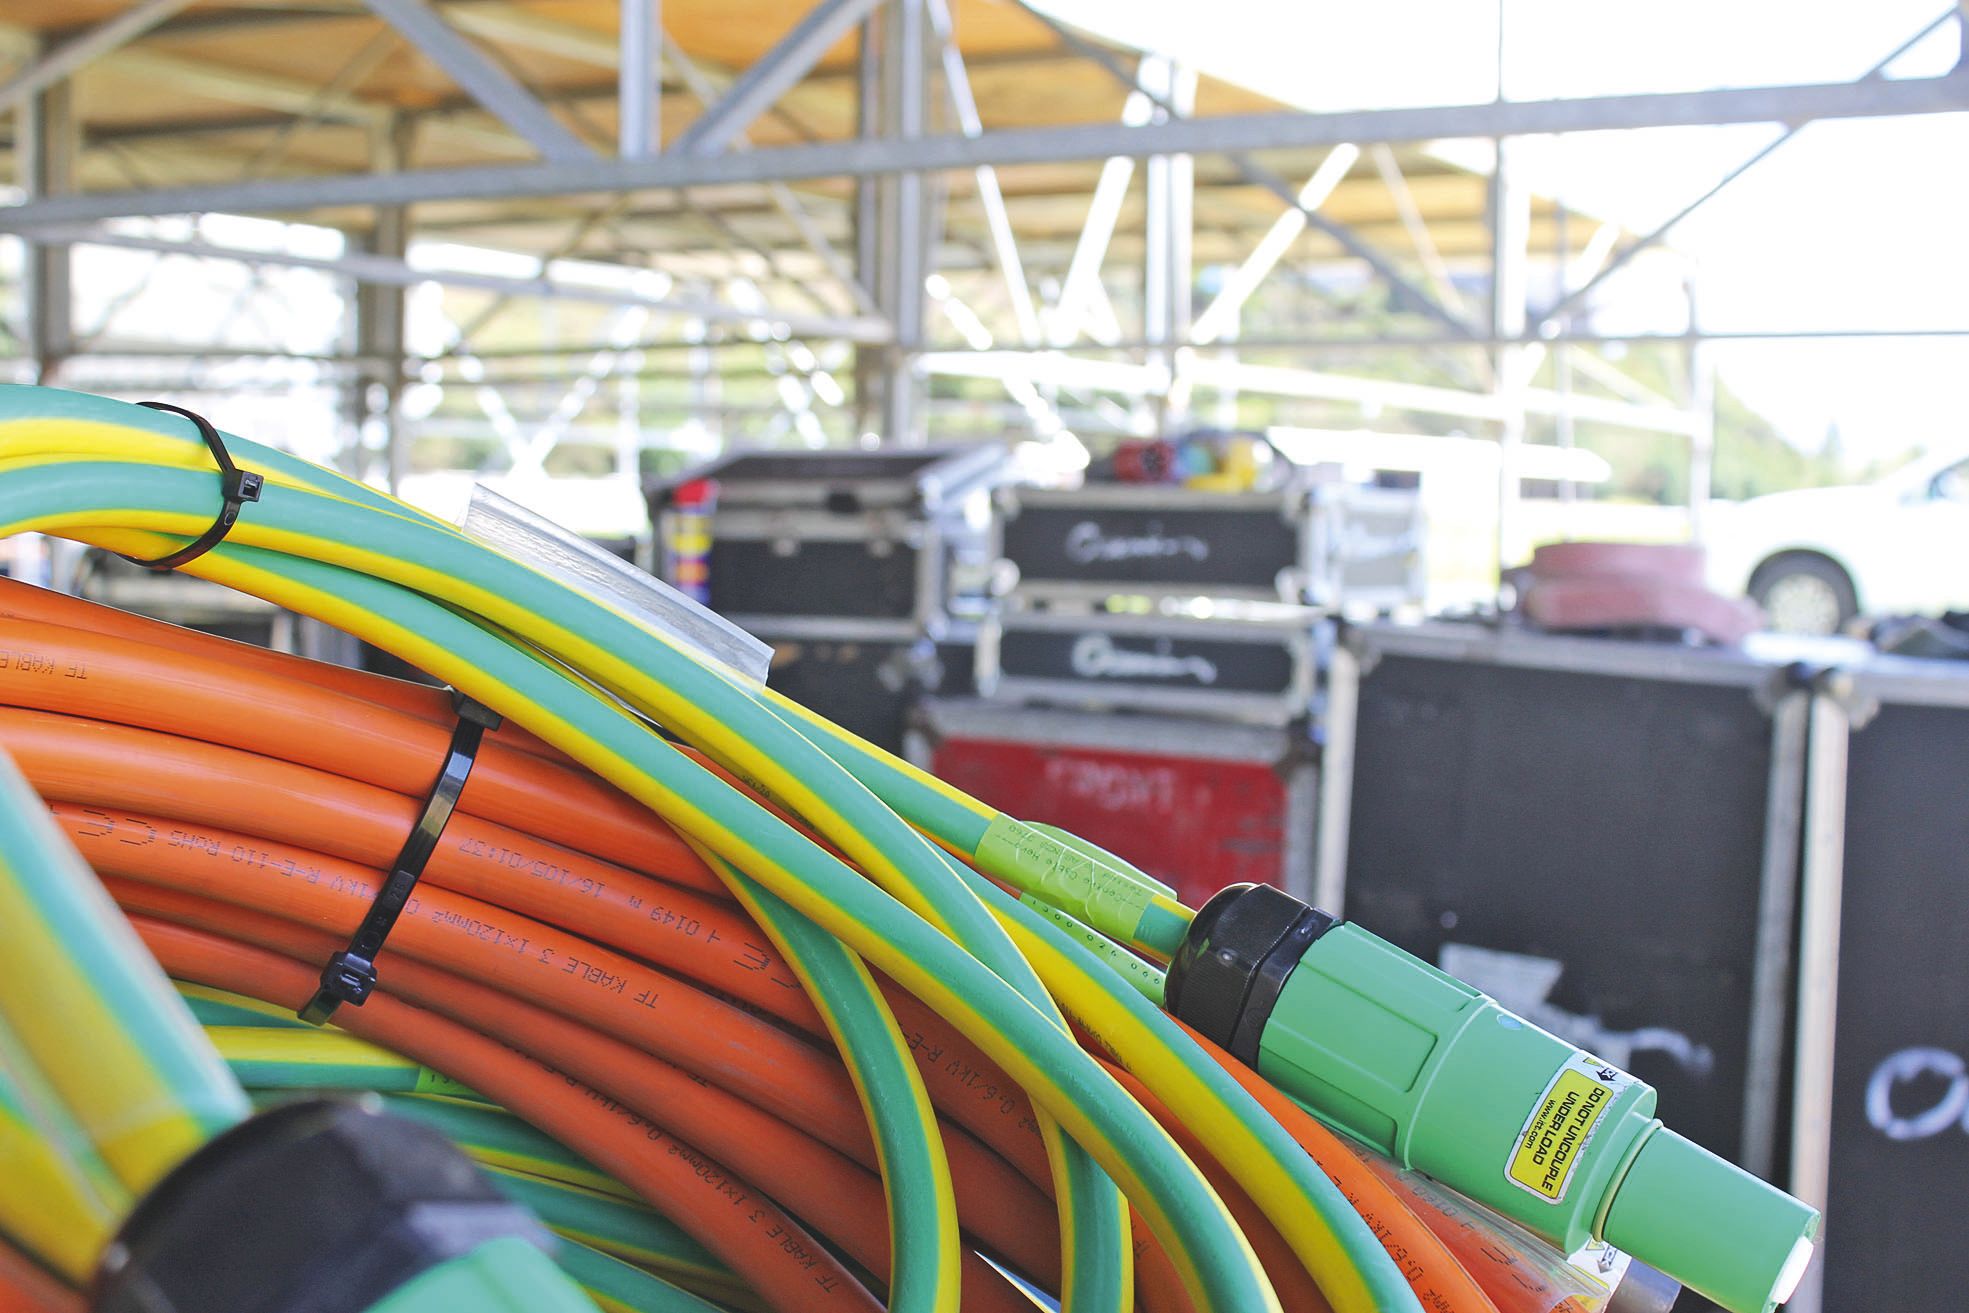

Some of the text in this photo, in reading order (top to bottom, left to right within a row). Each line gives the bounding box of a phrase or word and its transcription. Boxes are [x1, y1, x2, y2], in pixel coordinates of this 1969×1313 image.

[64, 662, 87, 680] TF
[230, 846, 321, 885] R-E-110
[650, 906, 701, 936] 0149
[538, 948, 555, 965] 3
[562, 956, 628, 994] KABLE
[633, 990, 659, 1008] TF
[1525, 1099, 1557, 1149] www.itt.com
[1532, 1091, 1580, 1166] UNDER LOAD
[1541, 1087, 1605, 1192] DO NOT UNCOUPLE
[748, 1209, 766, 1224] 3
[766, 1224, 819, 1270] KABLE
[814, 1275, 840, 1294] TF
